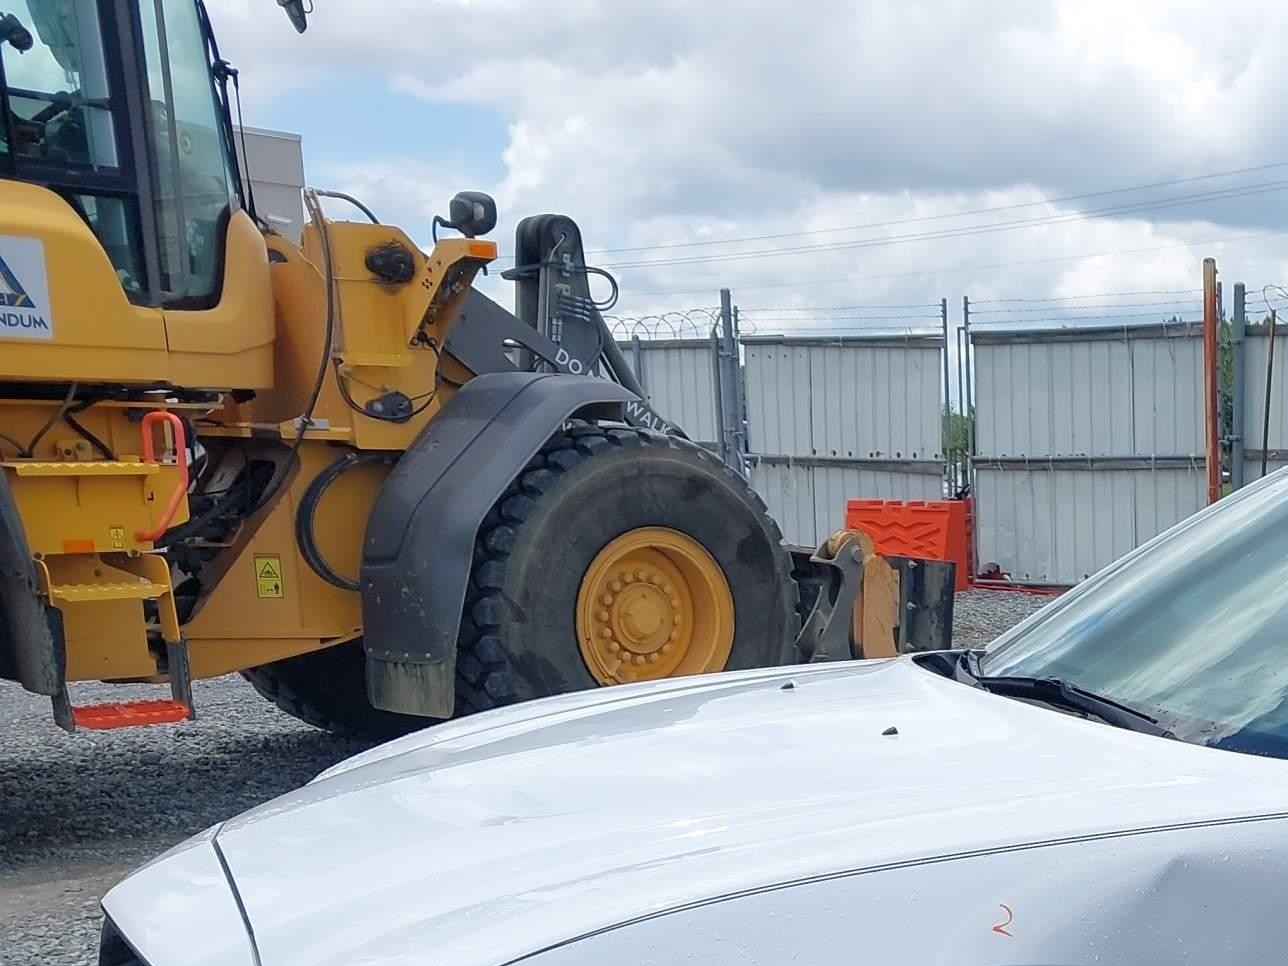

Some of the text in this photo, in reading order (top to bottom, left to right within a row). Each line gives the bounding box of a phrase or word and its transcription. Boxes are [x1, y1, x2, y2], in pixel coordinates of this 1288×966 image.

[555, 348, 671, 435] DO WALK
[991, 903, 1014, 938] 2
